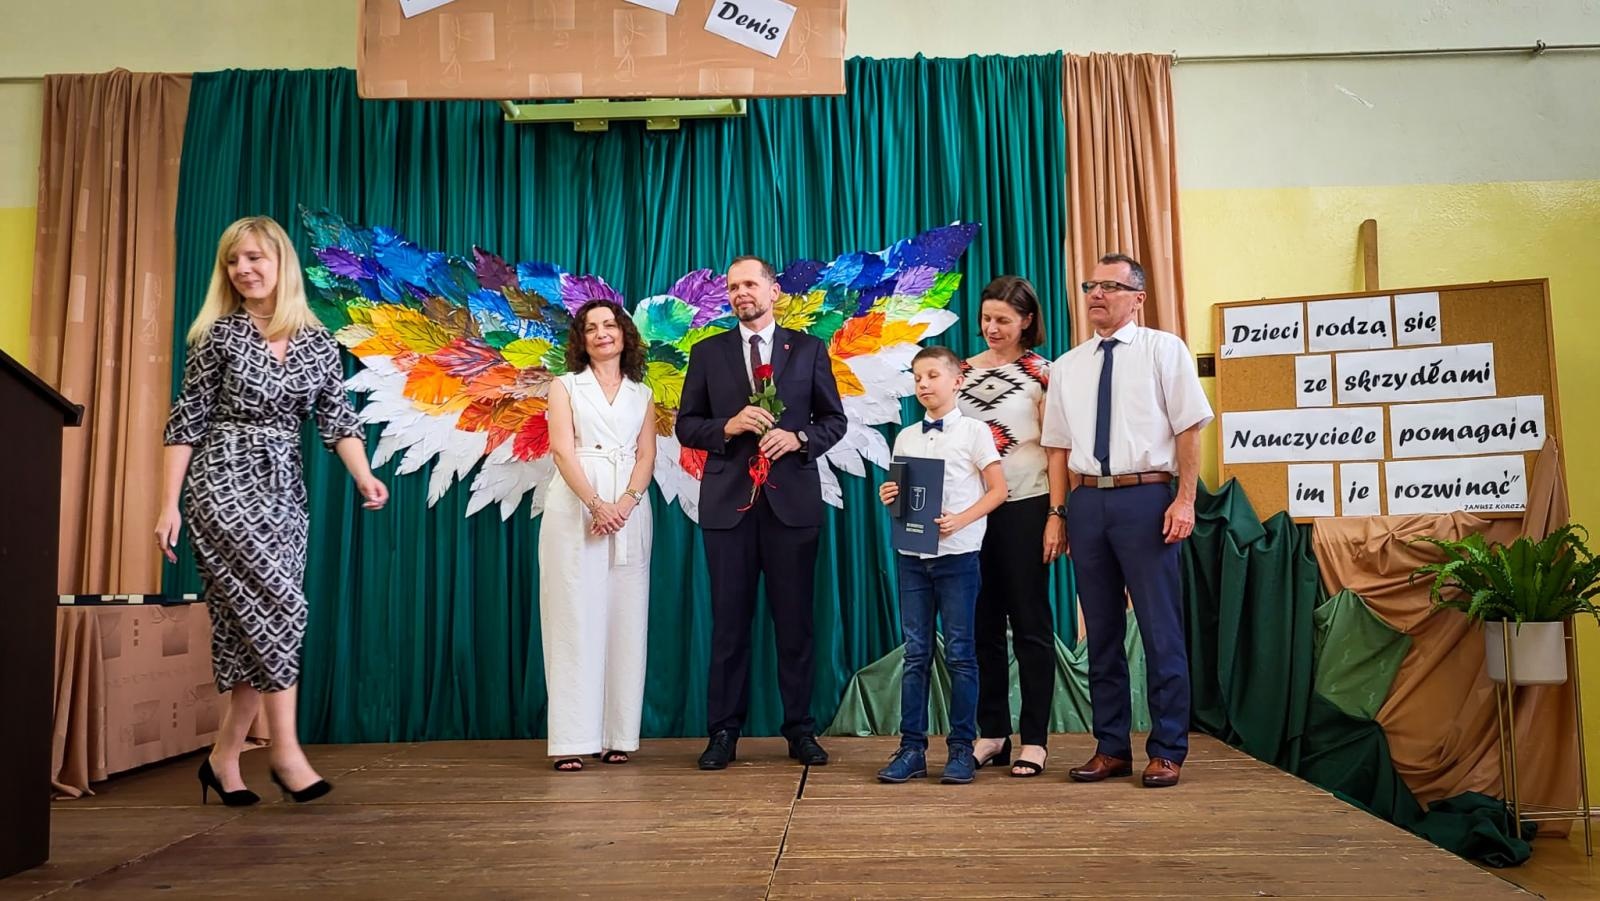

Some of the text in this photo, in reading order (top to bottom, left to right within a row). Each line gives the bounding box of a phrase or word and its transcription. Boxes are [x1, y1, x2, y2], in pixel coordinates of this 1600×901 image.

[717, 1, 780, 40] Denis
[1315, 315, 1387, 338] rodzą
[1404, 311, 1437, 333] się
[1303, 359, 1490, 393] ze skrzydłami
[1230, 416, 1539, 450] Nauczyciele pomagają
[1295, 482, 1325, 503] im
[1348, 481, 1369, 503] je
[1464, 503, 1494, 511] JANUSZ
